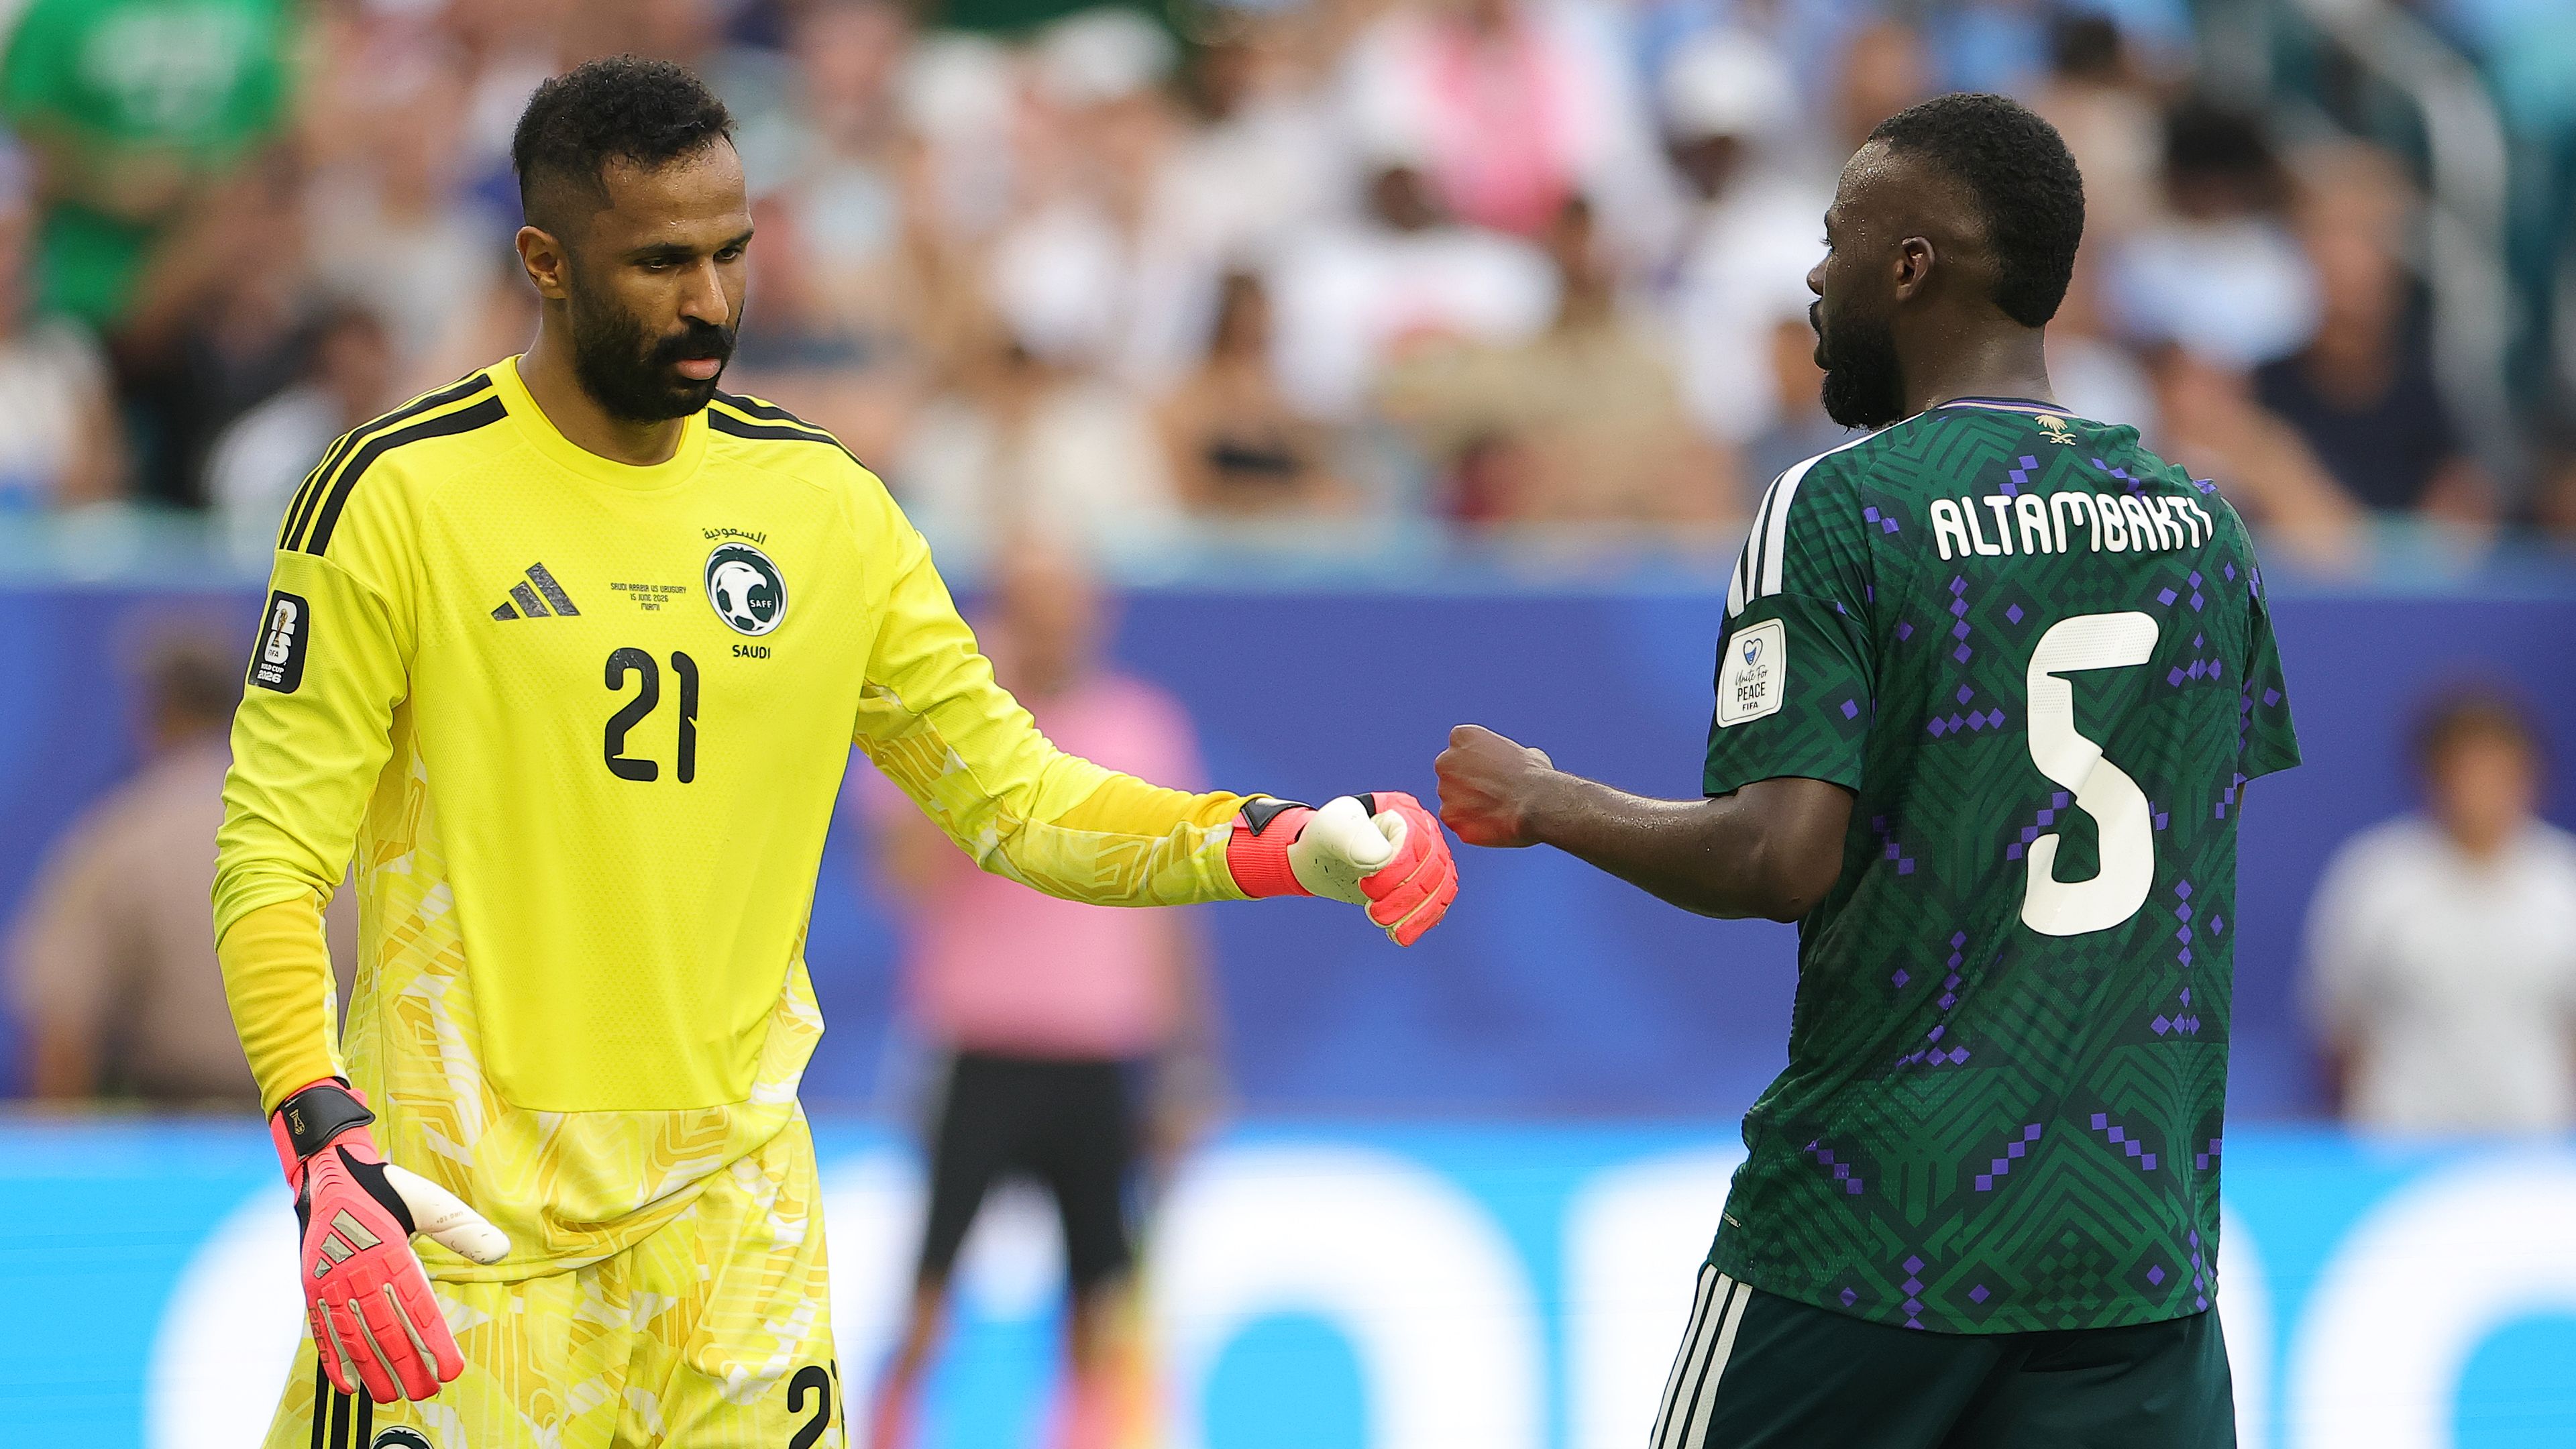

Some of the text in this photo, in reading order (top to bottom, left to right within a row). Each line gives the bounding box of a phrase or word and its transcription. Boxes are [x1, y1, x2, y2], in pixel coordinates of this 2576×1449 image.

[1929, 491, 2213, 561] ALTAMBAKTI
[702, 528, 767, 545] السعودية
[610, 582, 627, 590] SAUDI
[629, 584, 649, 592] ARABIA
[660, 586, 686, 594] URUGUAY
[653, 594, 668, 602] 2026
[750, 599, 772, 608] SAFF
[732, 645, 771, 659] SAUDI
[272, 665, 284, 674] CUP
[1735, 664, 1768, 686] Unite For
[1737, 682, 1766, 702] PEACE
[1742, 701, 1758, 711] FIFA
[604, 647, 699, 784] 21
[2021, 611, 2159, 936] 5
